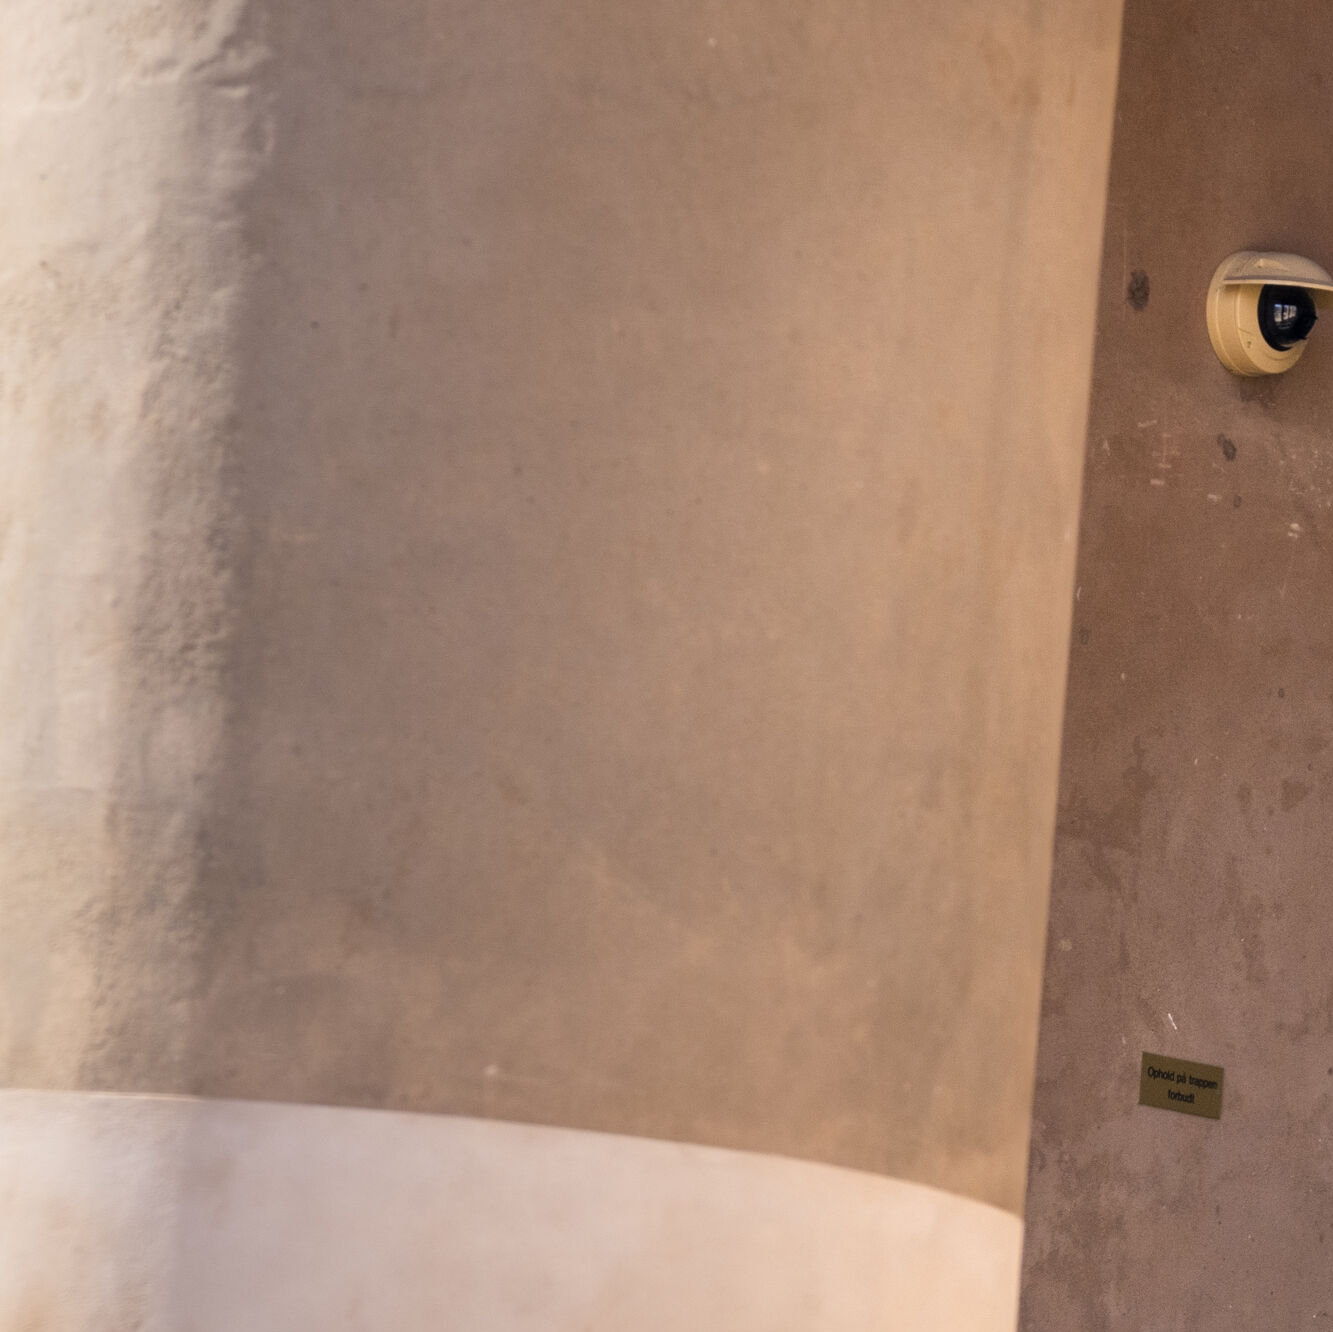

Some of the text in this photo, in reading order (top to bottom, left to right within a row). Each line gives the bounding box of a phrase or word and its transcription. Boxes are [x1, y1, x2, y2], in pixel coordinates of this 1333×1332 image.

[1147, 1066, 1218, 1090] Ophold på trappen
